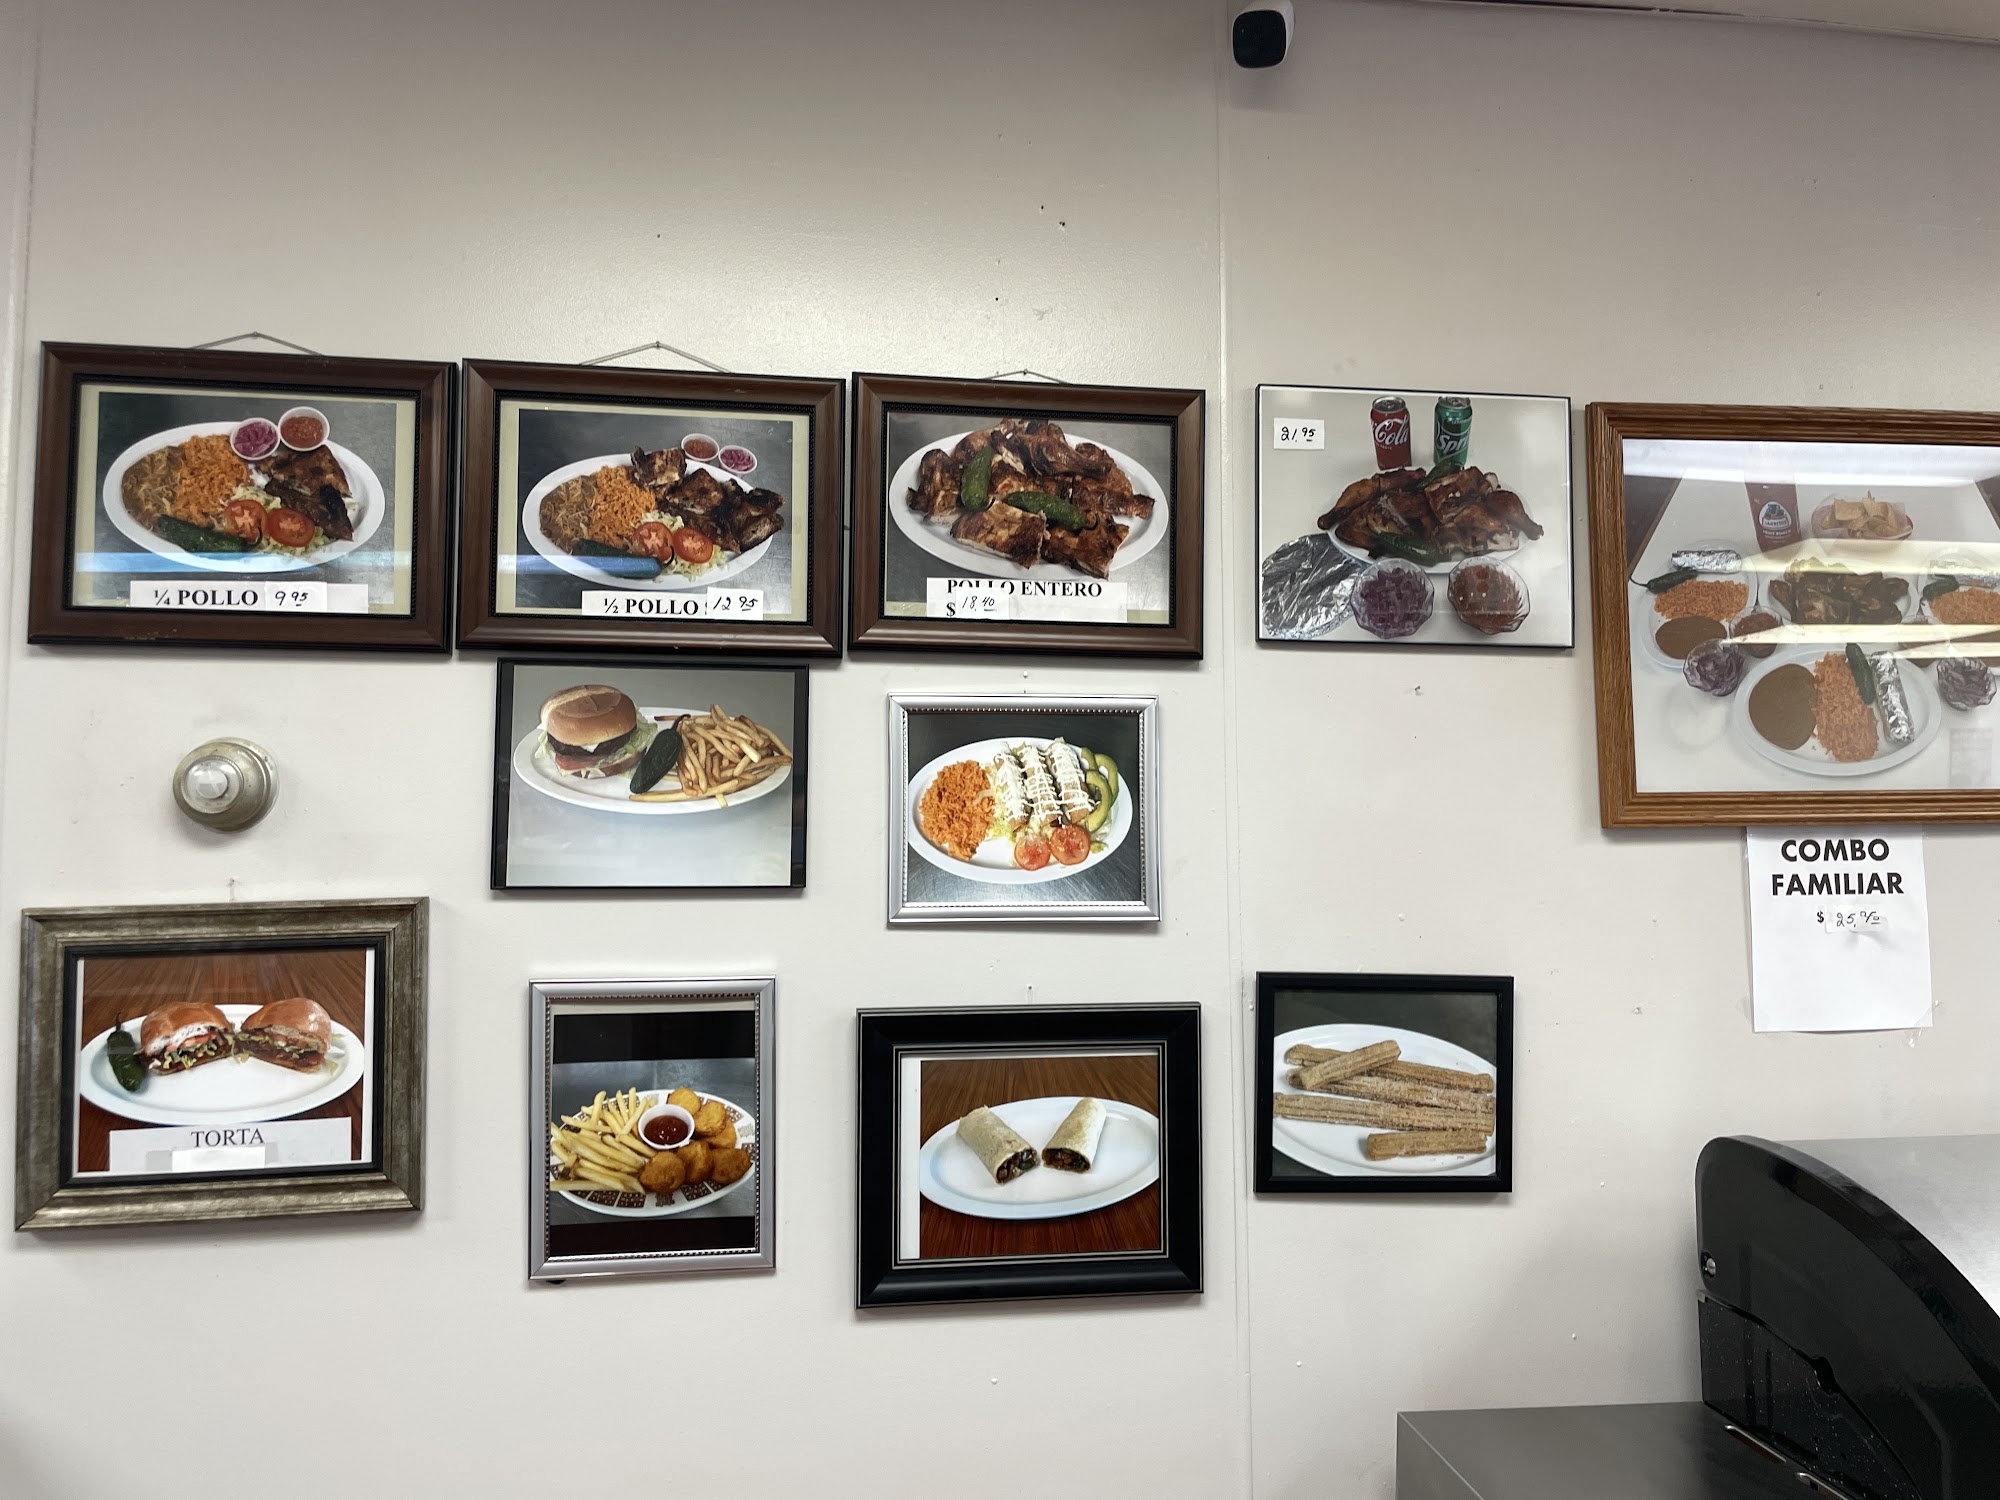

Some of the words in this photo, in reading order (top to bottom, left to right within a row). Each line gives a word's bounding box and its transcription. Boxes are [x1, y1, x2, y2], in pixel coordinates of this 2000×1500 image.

[178, 589, 259, 606] POLLO
[1021, 581, 1103, 598] ENTERO
[625, 598, 699, 615] POLLO
[1781, 838, 1890, 862] COMBO
[1772, 872, 1904, 896] FAMILIAR
[191, 1128, 265, 1147] TORTA
